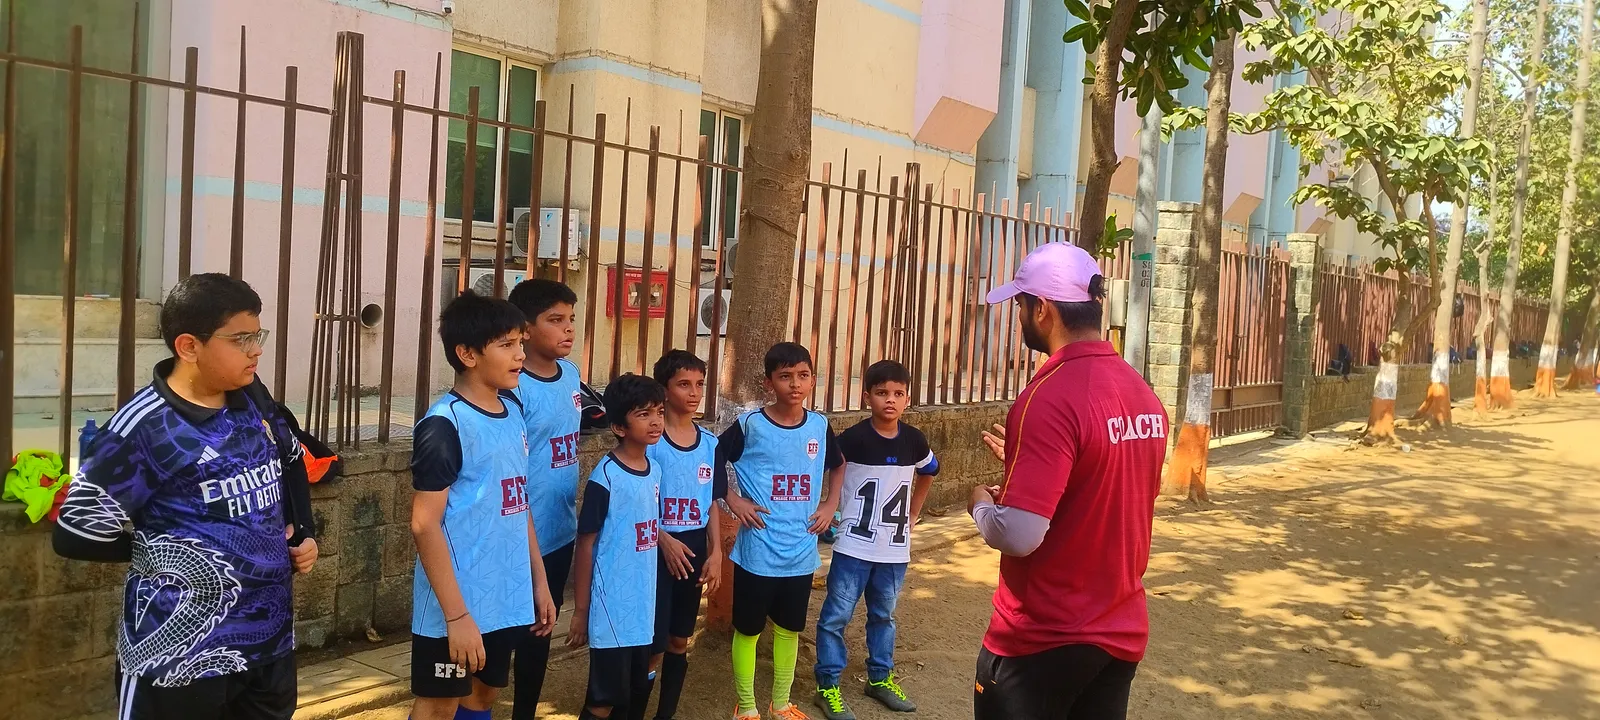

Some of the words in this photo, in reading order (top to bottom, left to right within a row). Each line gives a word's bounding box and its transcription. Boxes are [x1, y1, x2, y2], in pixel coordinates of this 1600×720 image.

[1107, 413, 1165, 445] COACH
[198, 458, 282, 504] Emirats
[772, 474, 810, 496] EFS
[227, 493, 252, 518] FLY
[662, 498, 701, 520] EFS
[845, 478, 911, 547] 14
[434, 662, 467, 679] EFS
